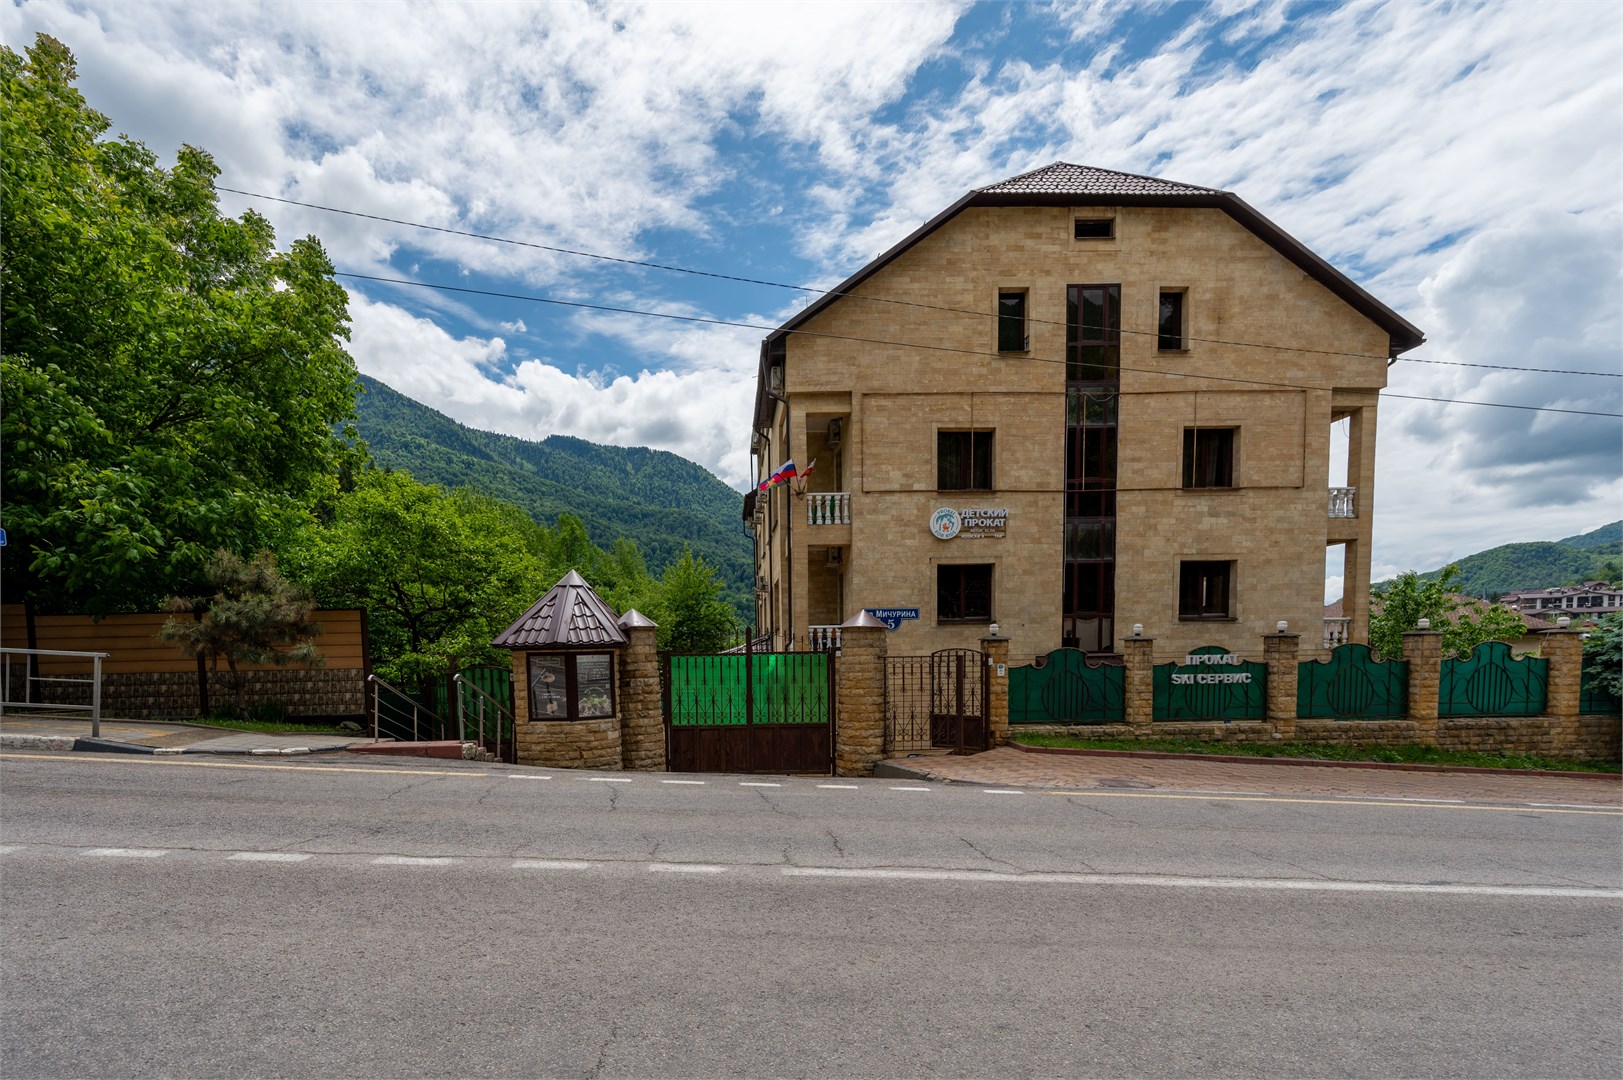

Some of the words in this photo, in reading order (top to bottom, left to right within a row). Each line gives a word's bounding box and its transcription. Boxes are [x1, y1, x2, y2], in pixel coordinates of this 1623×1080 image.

[961, 508, 1008, 518] ДЕТСКИЙ
[876, 610, 916, 618] МИЧУРИНА
[887, 619, 895, 630] 5
[1185, 654, 1239, 665] ПРОКАТ
[1171, 674, 1194, 684] SKI
[1196, 673, 1251, 684] СЕРВИС
